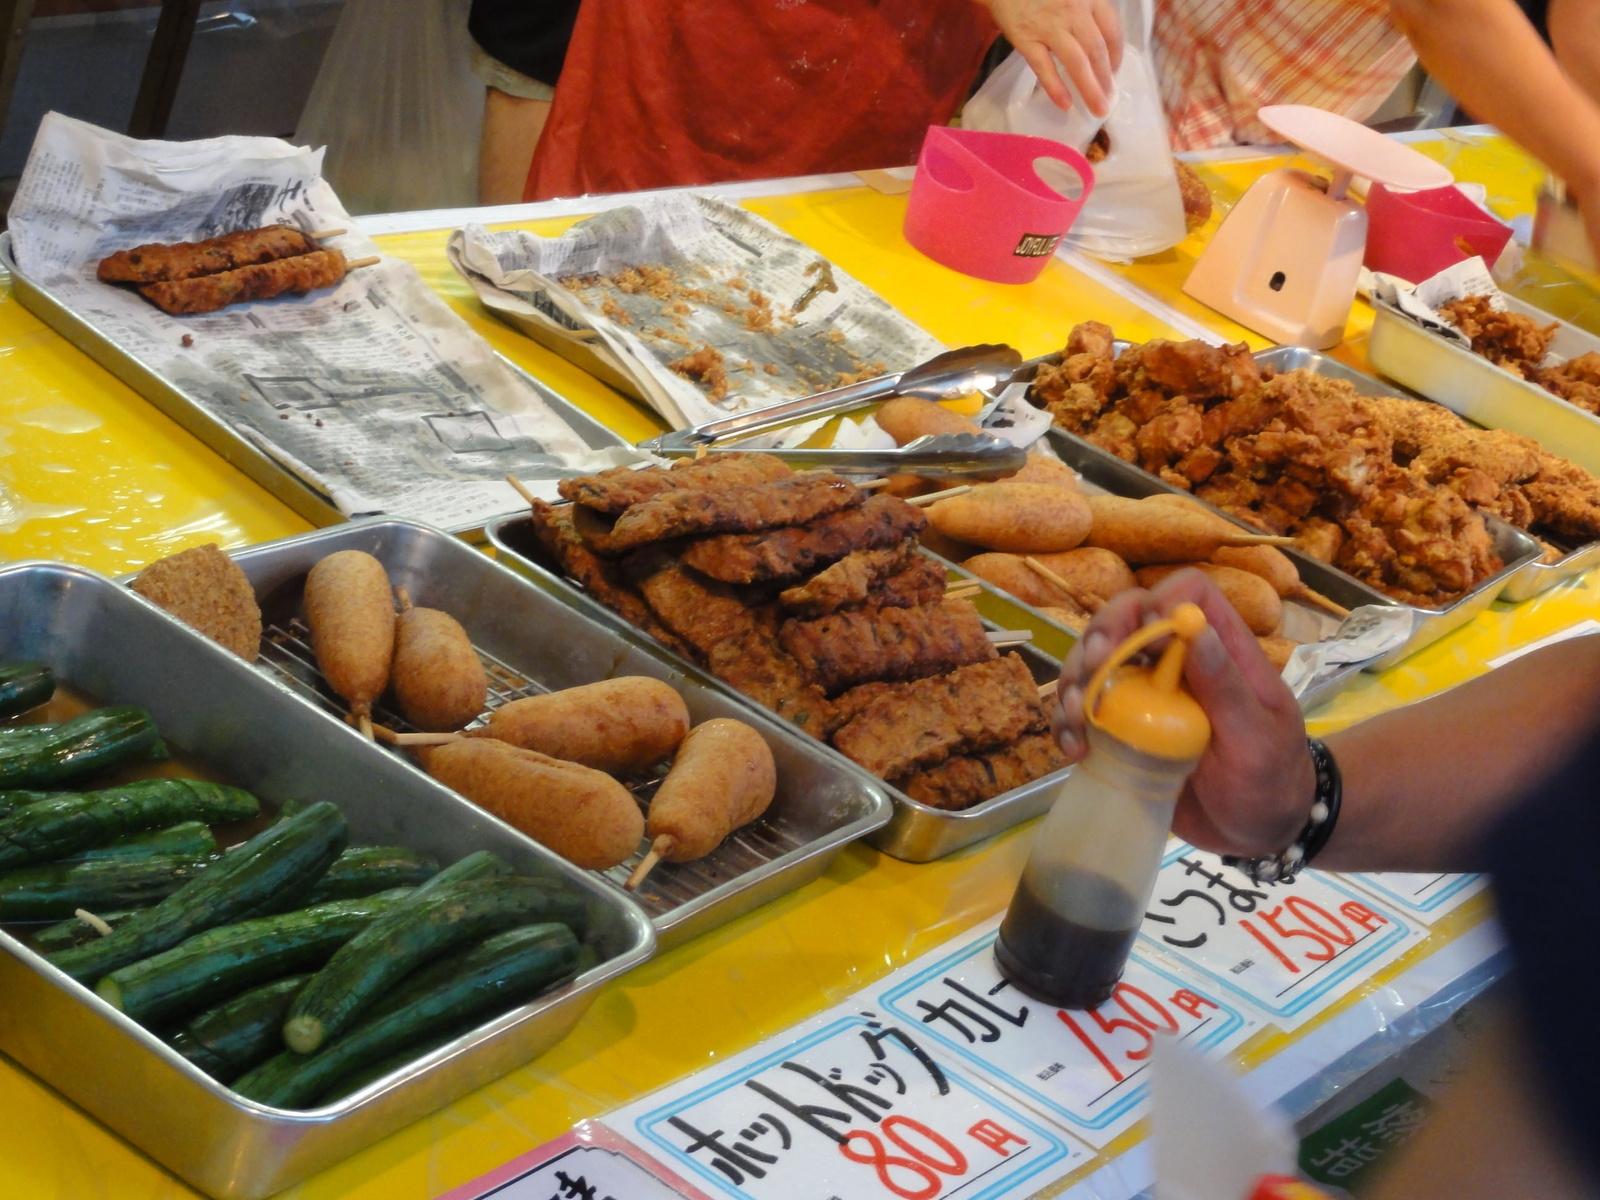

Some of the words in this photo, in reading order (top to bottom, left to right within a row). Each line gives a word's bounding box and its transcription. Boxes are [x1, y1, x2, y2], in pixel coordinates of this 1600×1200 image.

[672, 1011, 949, 1187] ホットドッグ
[838, 1114, 1029, 1200] 80円
